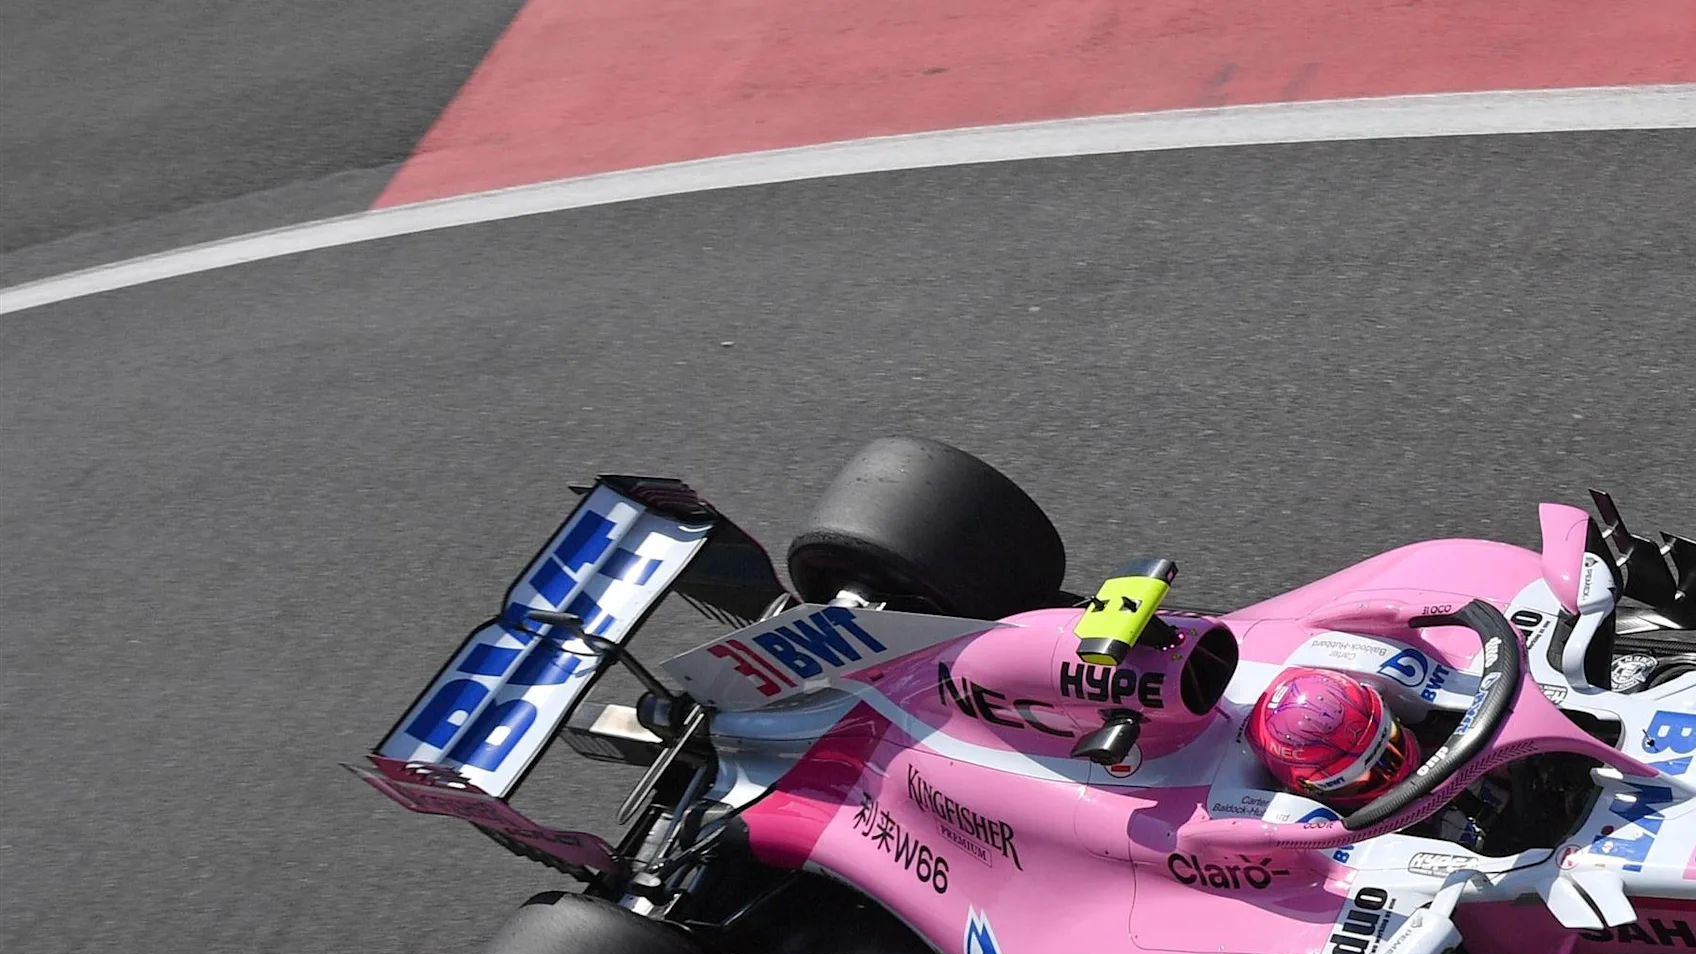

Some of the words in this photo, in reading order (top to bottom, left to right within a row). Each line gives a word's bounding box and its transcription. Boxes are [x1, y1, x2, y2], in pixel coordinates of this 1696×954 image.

[405, 508, 662, 772] BWT
[706, 639, 798, 697] 31
[752, 606, 888, 679] BWT
[937, 660, 1075, 738] NEC
[1060, 661, 1166, 709] HYPE
[1420, 664, 1451, 702] BWT
[1270, 744, 1304, 760] NEC
[1416, 745, 1449, 777] duo
[907, 763, 1024, 871] KINGFISHER
[853, 792, 950, 894] 利来W66
[940, 826, 988, 861] PREMIUM
[1167, 852, 1290, 890] Claro
